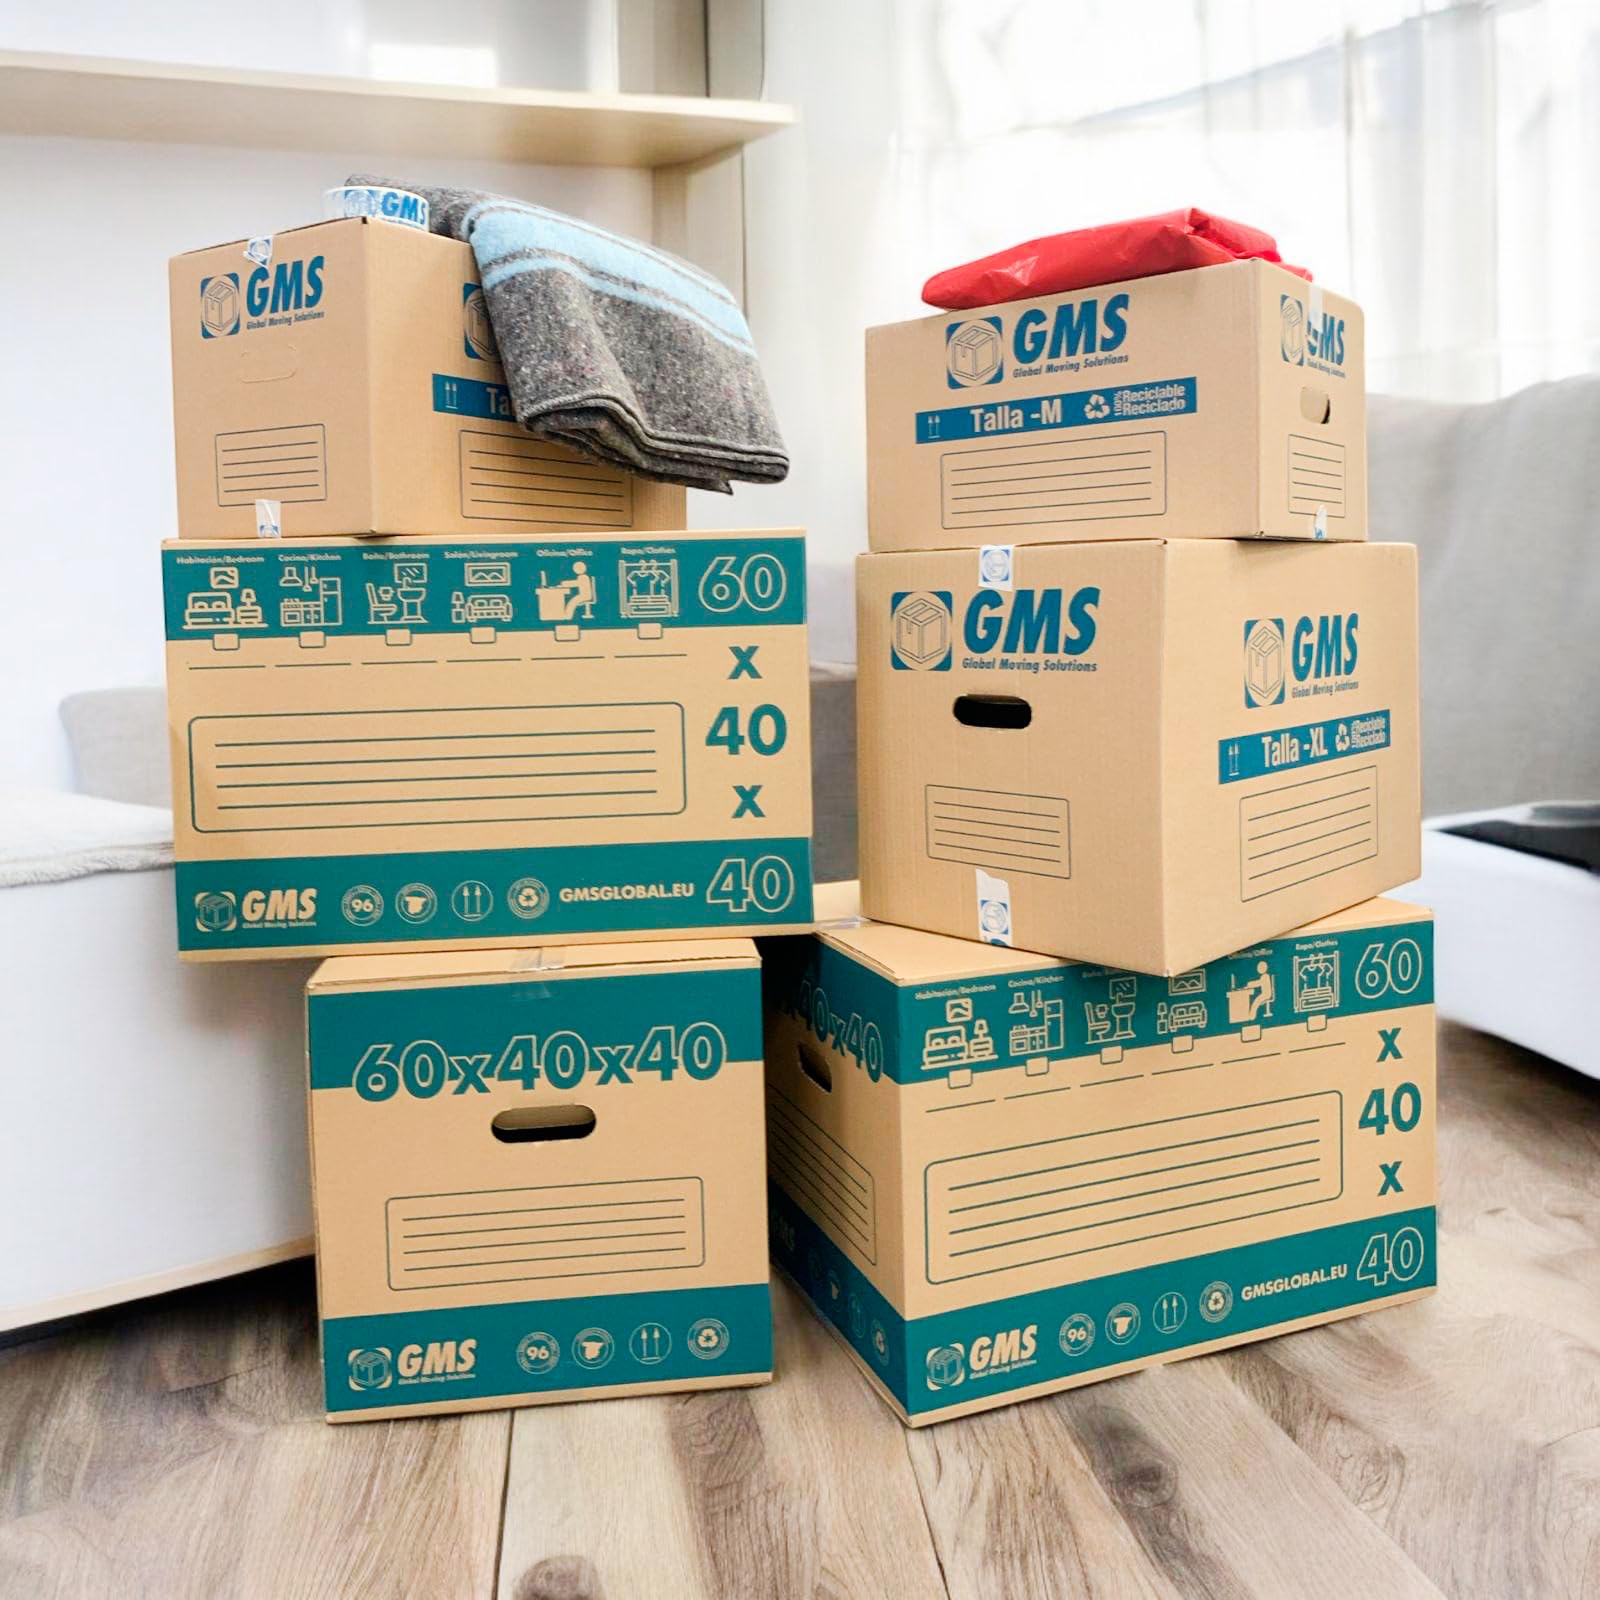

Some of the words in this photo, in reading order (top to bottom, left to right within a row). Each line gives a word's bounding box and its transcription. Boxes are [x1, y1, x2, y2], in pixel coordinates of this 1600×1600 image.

[381, 191, 426, 225] GMS
[246, 255, 325, 317] GMS
[1013, 293, 1130, 366] GMS
[1012, 365, 1042, 378] Global
[1045, 360, 1080, 373] Moving
[1083, 354, 1129, 368] Solutions
[1122, 383, 1185, 402] Reciclable
[1122, 398, 1186, 416] Reciclado
[970, 406, 1024, 433] Talla
[1030, 399, 1062, 424] -M
[698, 553, 787, 613] 60
[963, 586, 1101, 656] GMS
[962, 657, 995, 670] Global
[999, 658, 1040, 674] Moving
[1043, 658, 1098, 672] Solutions
[1291, 612, 1359, 682] GMS
[705, 703, 787, 757] 40
[1261, 733, 1300, 768] Talla
[1303, 726, 1329, 759] -XL
[559, 882, 695, 903] GMSGLOBAL.EU
[706, 855, 795, 912] 40
[241, 887, 318, 922] GMS
[351, 898, 374, 913] 96
[1354, 937, 1423, 999] 60
[352, 1021, 728, 1102] 60x40x40
[1358, 1081, 1422, 1136] 40
[1356, 1226, 1425, 1287] 40
[1241, 1263, 1348, 1301] GMSGLOBAL.EU
[526, 1345, 550, 1360] 96
[969, 1324, 1038, 1371] GMS
[1067, 1326, 1087, 1343] 96
[397, 1338, 478, 1377] GMS
